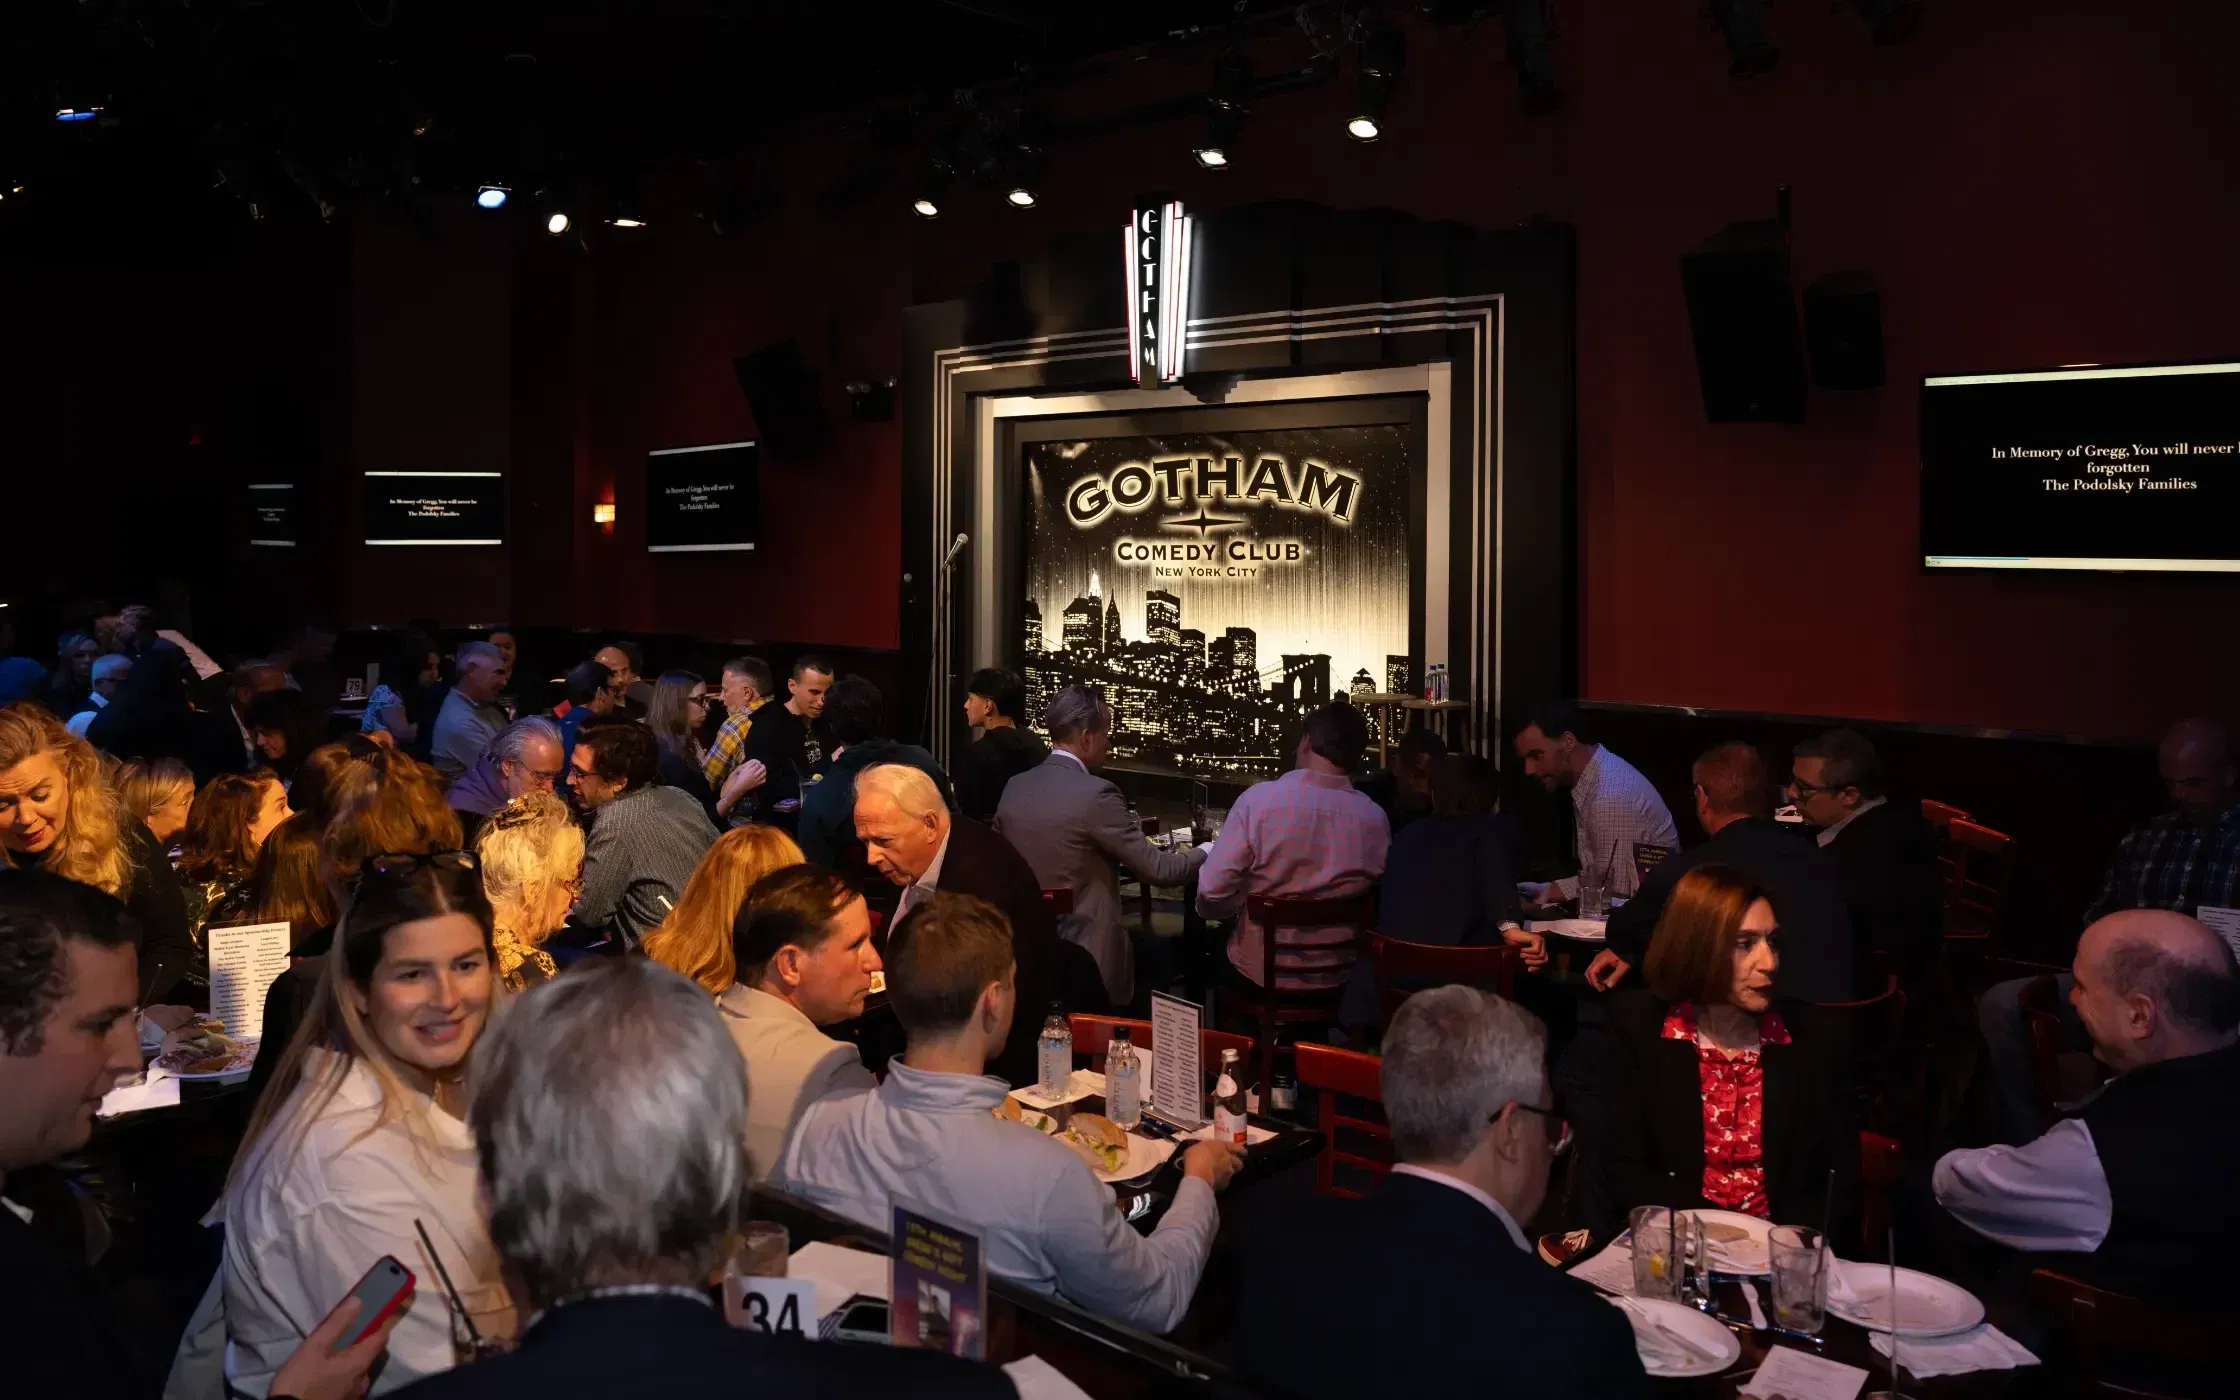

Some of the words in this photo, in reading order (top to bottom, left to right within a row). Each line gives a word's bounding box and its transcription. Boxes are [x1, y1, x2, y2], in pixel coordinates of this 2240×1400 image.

[1992, 448, 2005, 458] In
[2010, 447, 2063, 460] Memory
[2067, 446, 2082, 456] of
[2085, 445, 2129, 458] Gregg,
[2132, 444, 2158, 455] You
[2163, 443, 2188, 454] will
[2193, 444, 2234, 454] never
[2087, 462, 2150, 476] forgotten
[1069, 457, 1360, 522] GOTHAM
[2043, 479, 2069, 490] The
[2073, 478, 2134, 493] Podolsky
[2139, 478, 2197, 490] Families
[1117, 542, 1216, 561] COMEDY
[1228, 541, 1300, 561] CLUB
[1155, 566, 1183, 577] NEW
[1188, 566, 1221, 577] YORK
[1226, 566, 1258, 577] CITY
[349, 680, 360, 690] 79
[742, 1292, 804, 1337] 34
